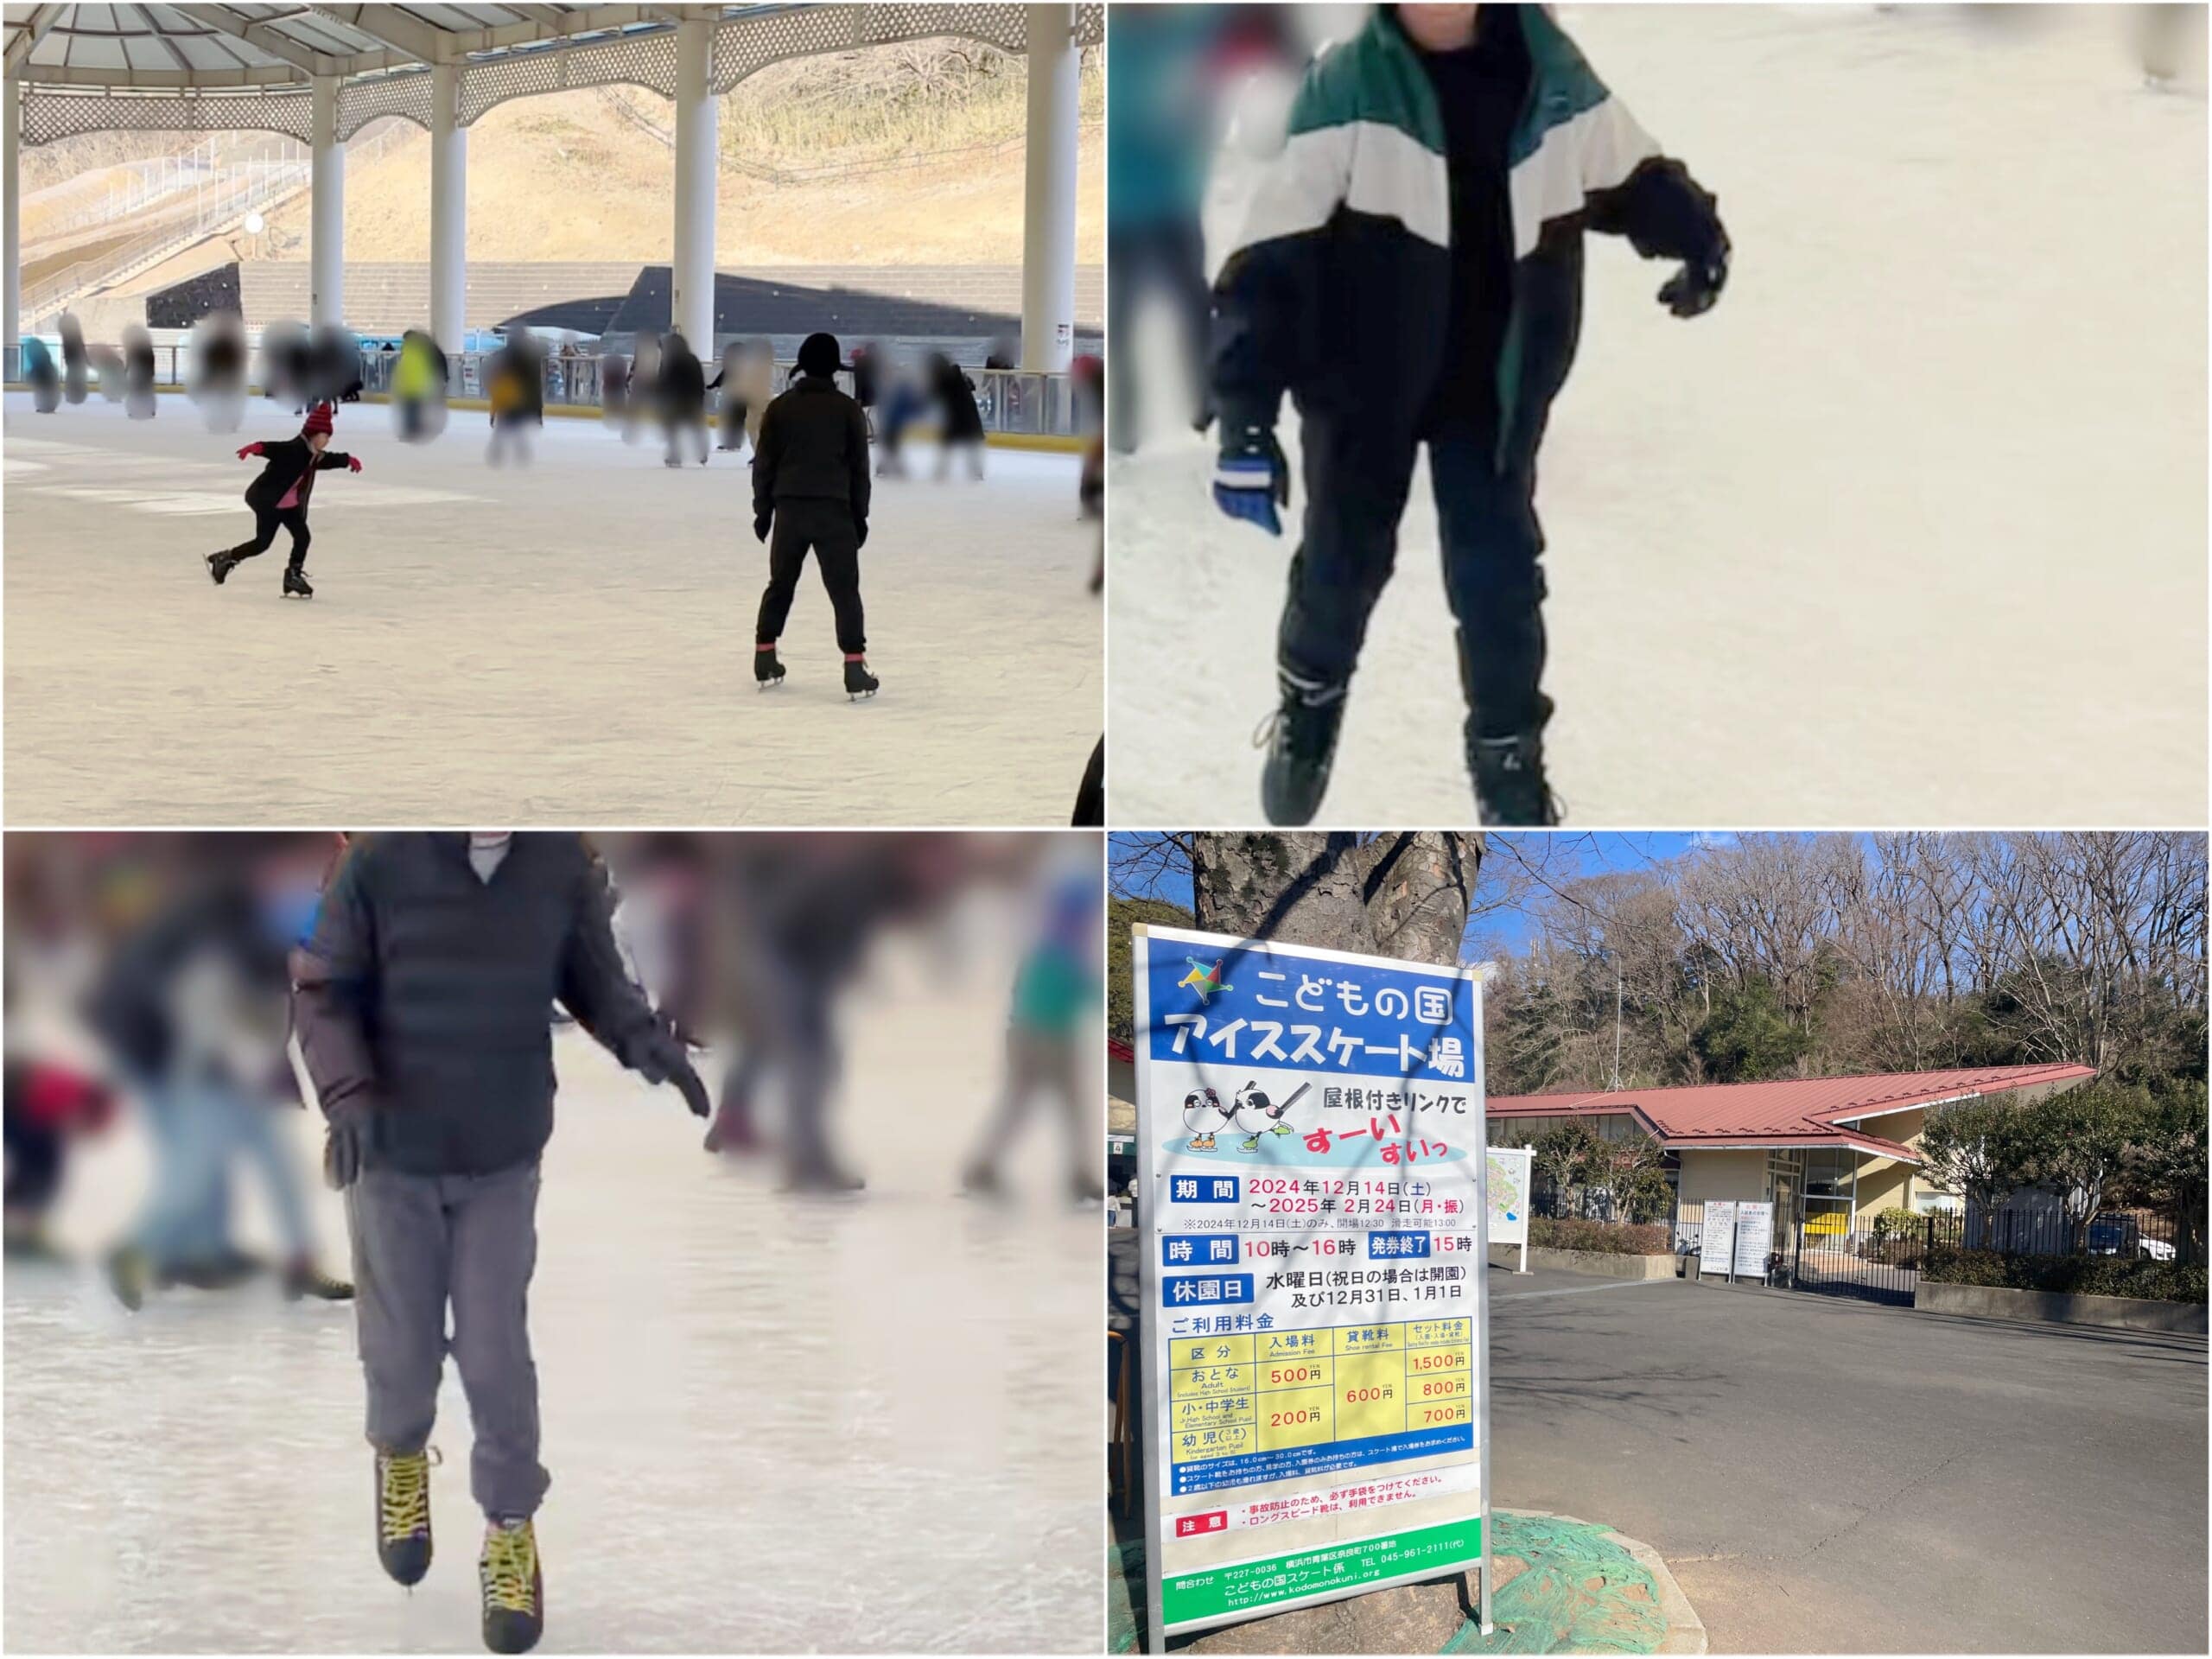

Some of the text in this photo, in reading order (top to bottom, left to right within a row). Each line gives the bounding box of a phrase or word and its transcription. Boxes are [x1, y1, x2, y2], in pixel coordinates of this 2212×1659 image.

[1255, 970, 1454, 1026] こどもの国
[1164, 1013, 1465, 1078] アイススケート場
[1323, 1087, 1467, 1115] 屋根付きリンクで
[1302, 1114, 1402, 1154] すーい
[1380, 1139, 1449, 1166] すいっ
[1176, 1179, 1234, 1199] 期間
[1249, 1179, 1431, 1197] 2024年12月14日(土)
[1169, 1239, 1233, 1261] 時間
[1244, 1238, 1357, 1258] 10時～16時
[1371, 1236, 1426, 1255] 発券終了
[1433, 1236, 1472, 1252] 15時
[1266, 1266, 1466, 1290] 水曜日(祝日の場合は開園)
[1173, 1280, 1243, 1302] 休園日
[1291, 1285, 1462, 1308] 及び12月31日、1月1日
[1172, 1313, 1274, 1333] ご利用料金
[1414, 1321, 1464, 1333] セット料金
[1269, 1334, 1315, 1349] 入場料
[1346, 1328, 1389, 1343] 貸靴料
[1191, 1345, 1231, 1360] 区分
[1269, 1349, 1301, 1357] Admission
[1413, 1354, 1465, 1370] 1,500円
[1192, 1366, 1239, 1382] おとな
[1271, 1368, 1321, 1383] 500円
[1346, 1388, 1393, 1403] 600円
[1423, 1381, 1465, 1396] 800円
[1181, 1396, 1249, 1414] 小・中学生
[1271, 1410, 1320, 1427] 200円
[1424, 1408, 1465, 1423] 700円
[1185, 1446, 1227, 1455] Kindergarten
[1175, 1576, 1214, 1591] 問合わせ
[1224, 1562, 1345, 1596] こどもの国スケート係
[1362, 1558, 1376, 1567] TEL
